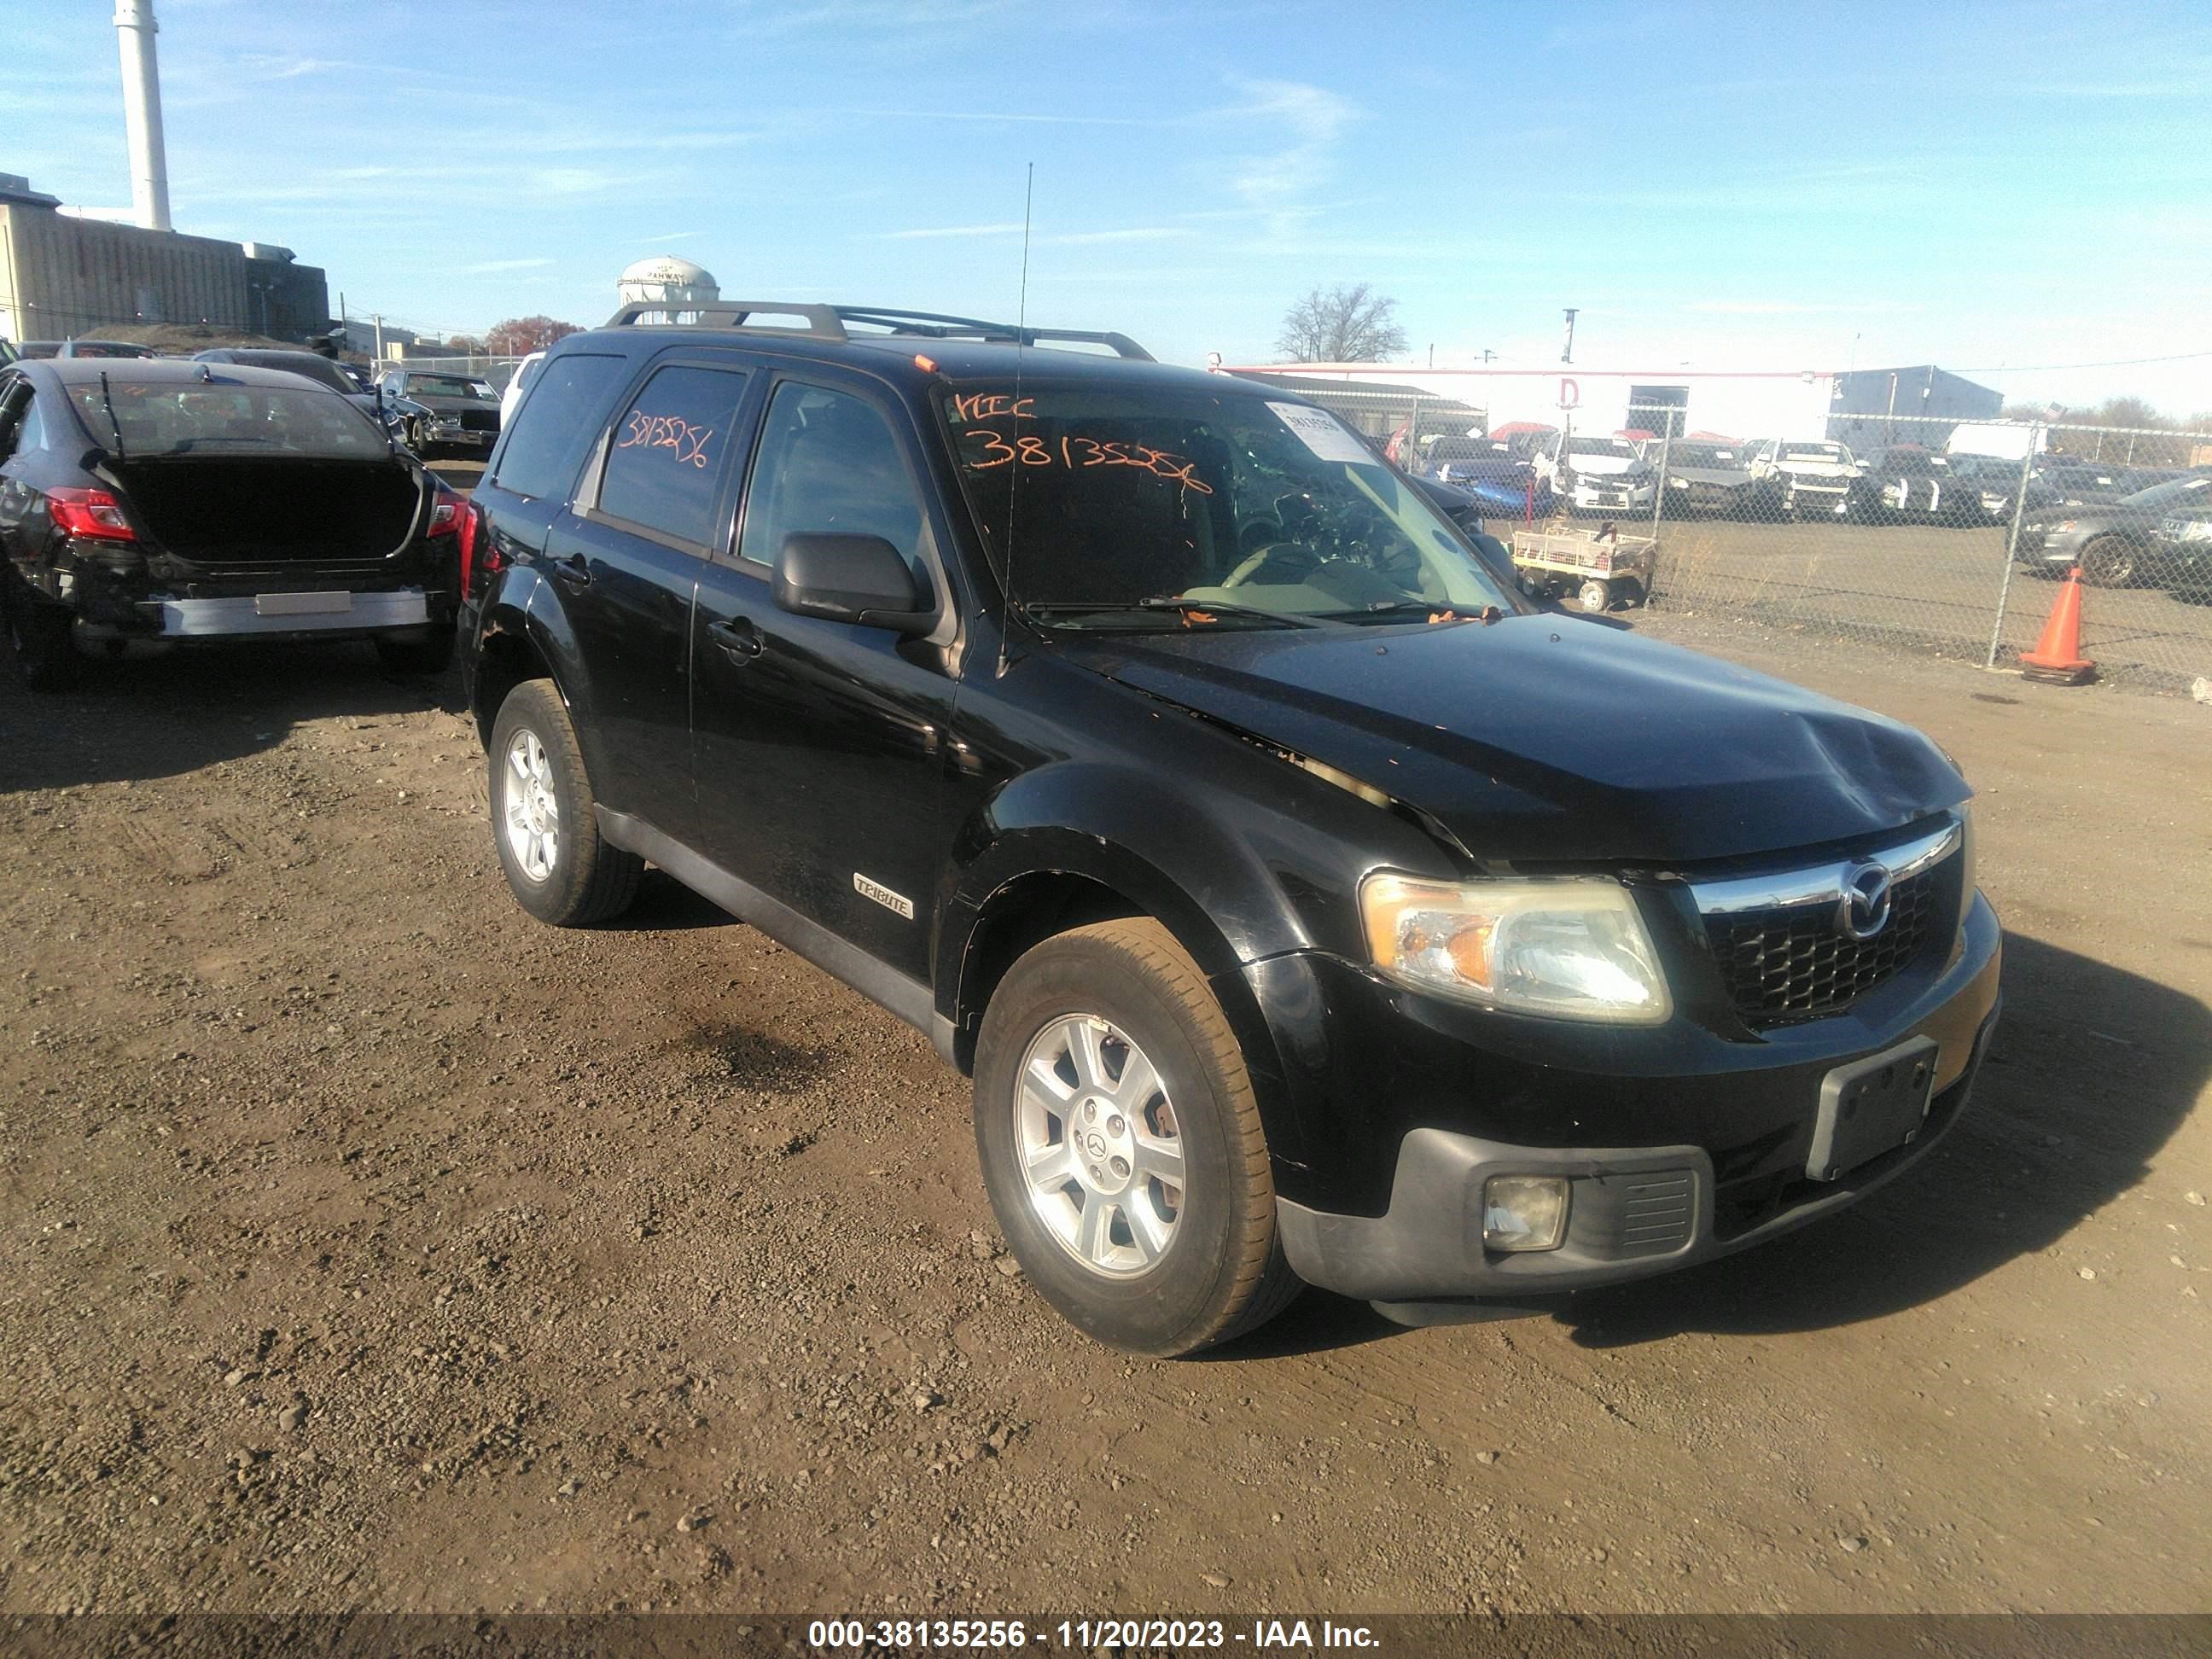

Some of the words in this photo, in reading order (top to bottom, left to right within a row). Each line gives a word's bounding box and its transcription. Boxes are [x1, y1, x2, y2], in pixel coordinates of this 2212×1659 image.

[1560, 378, 1579, 410] D
[619, 410, 713, 468] 38135256
[962, 430, 1213, 494] 38135256
[857, 878, 908, 915] TRIBUTE
